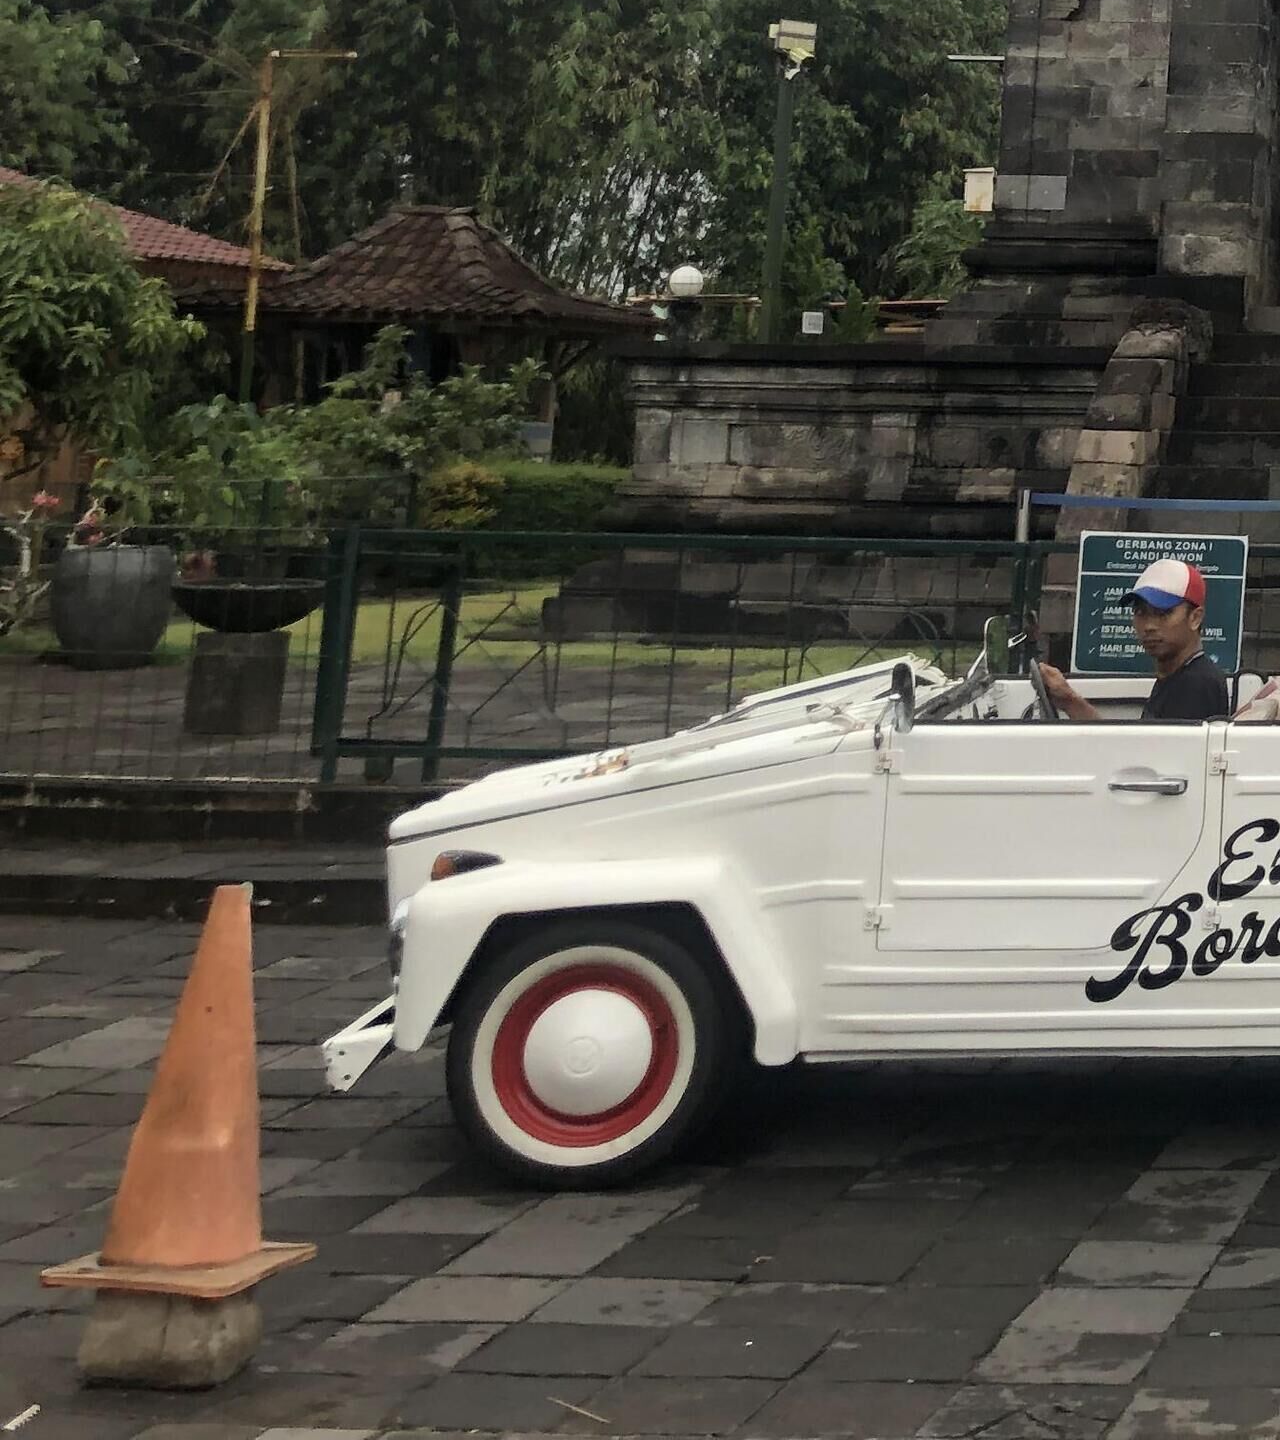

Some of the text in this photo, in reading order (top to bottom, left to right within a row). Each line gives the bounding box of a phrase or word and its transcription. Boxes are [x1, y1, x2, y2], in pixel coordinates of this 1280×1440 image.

[1115, 539, 1213, 551] GERBANG ZONA I
[1124, 551, 1204, 562] CANDI PAWON
[1104, 587, 1124, 596] JAM
[1102, 606, 1122, 614] JAM
[1205, 628, 1223, 636] WIB
[1100, 644, 1122, 652] HARI
